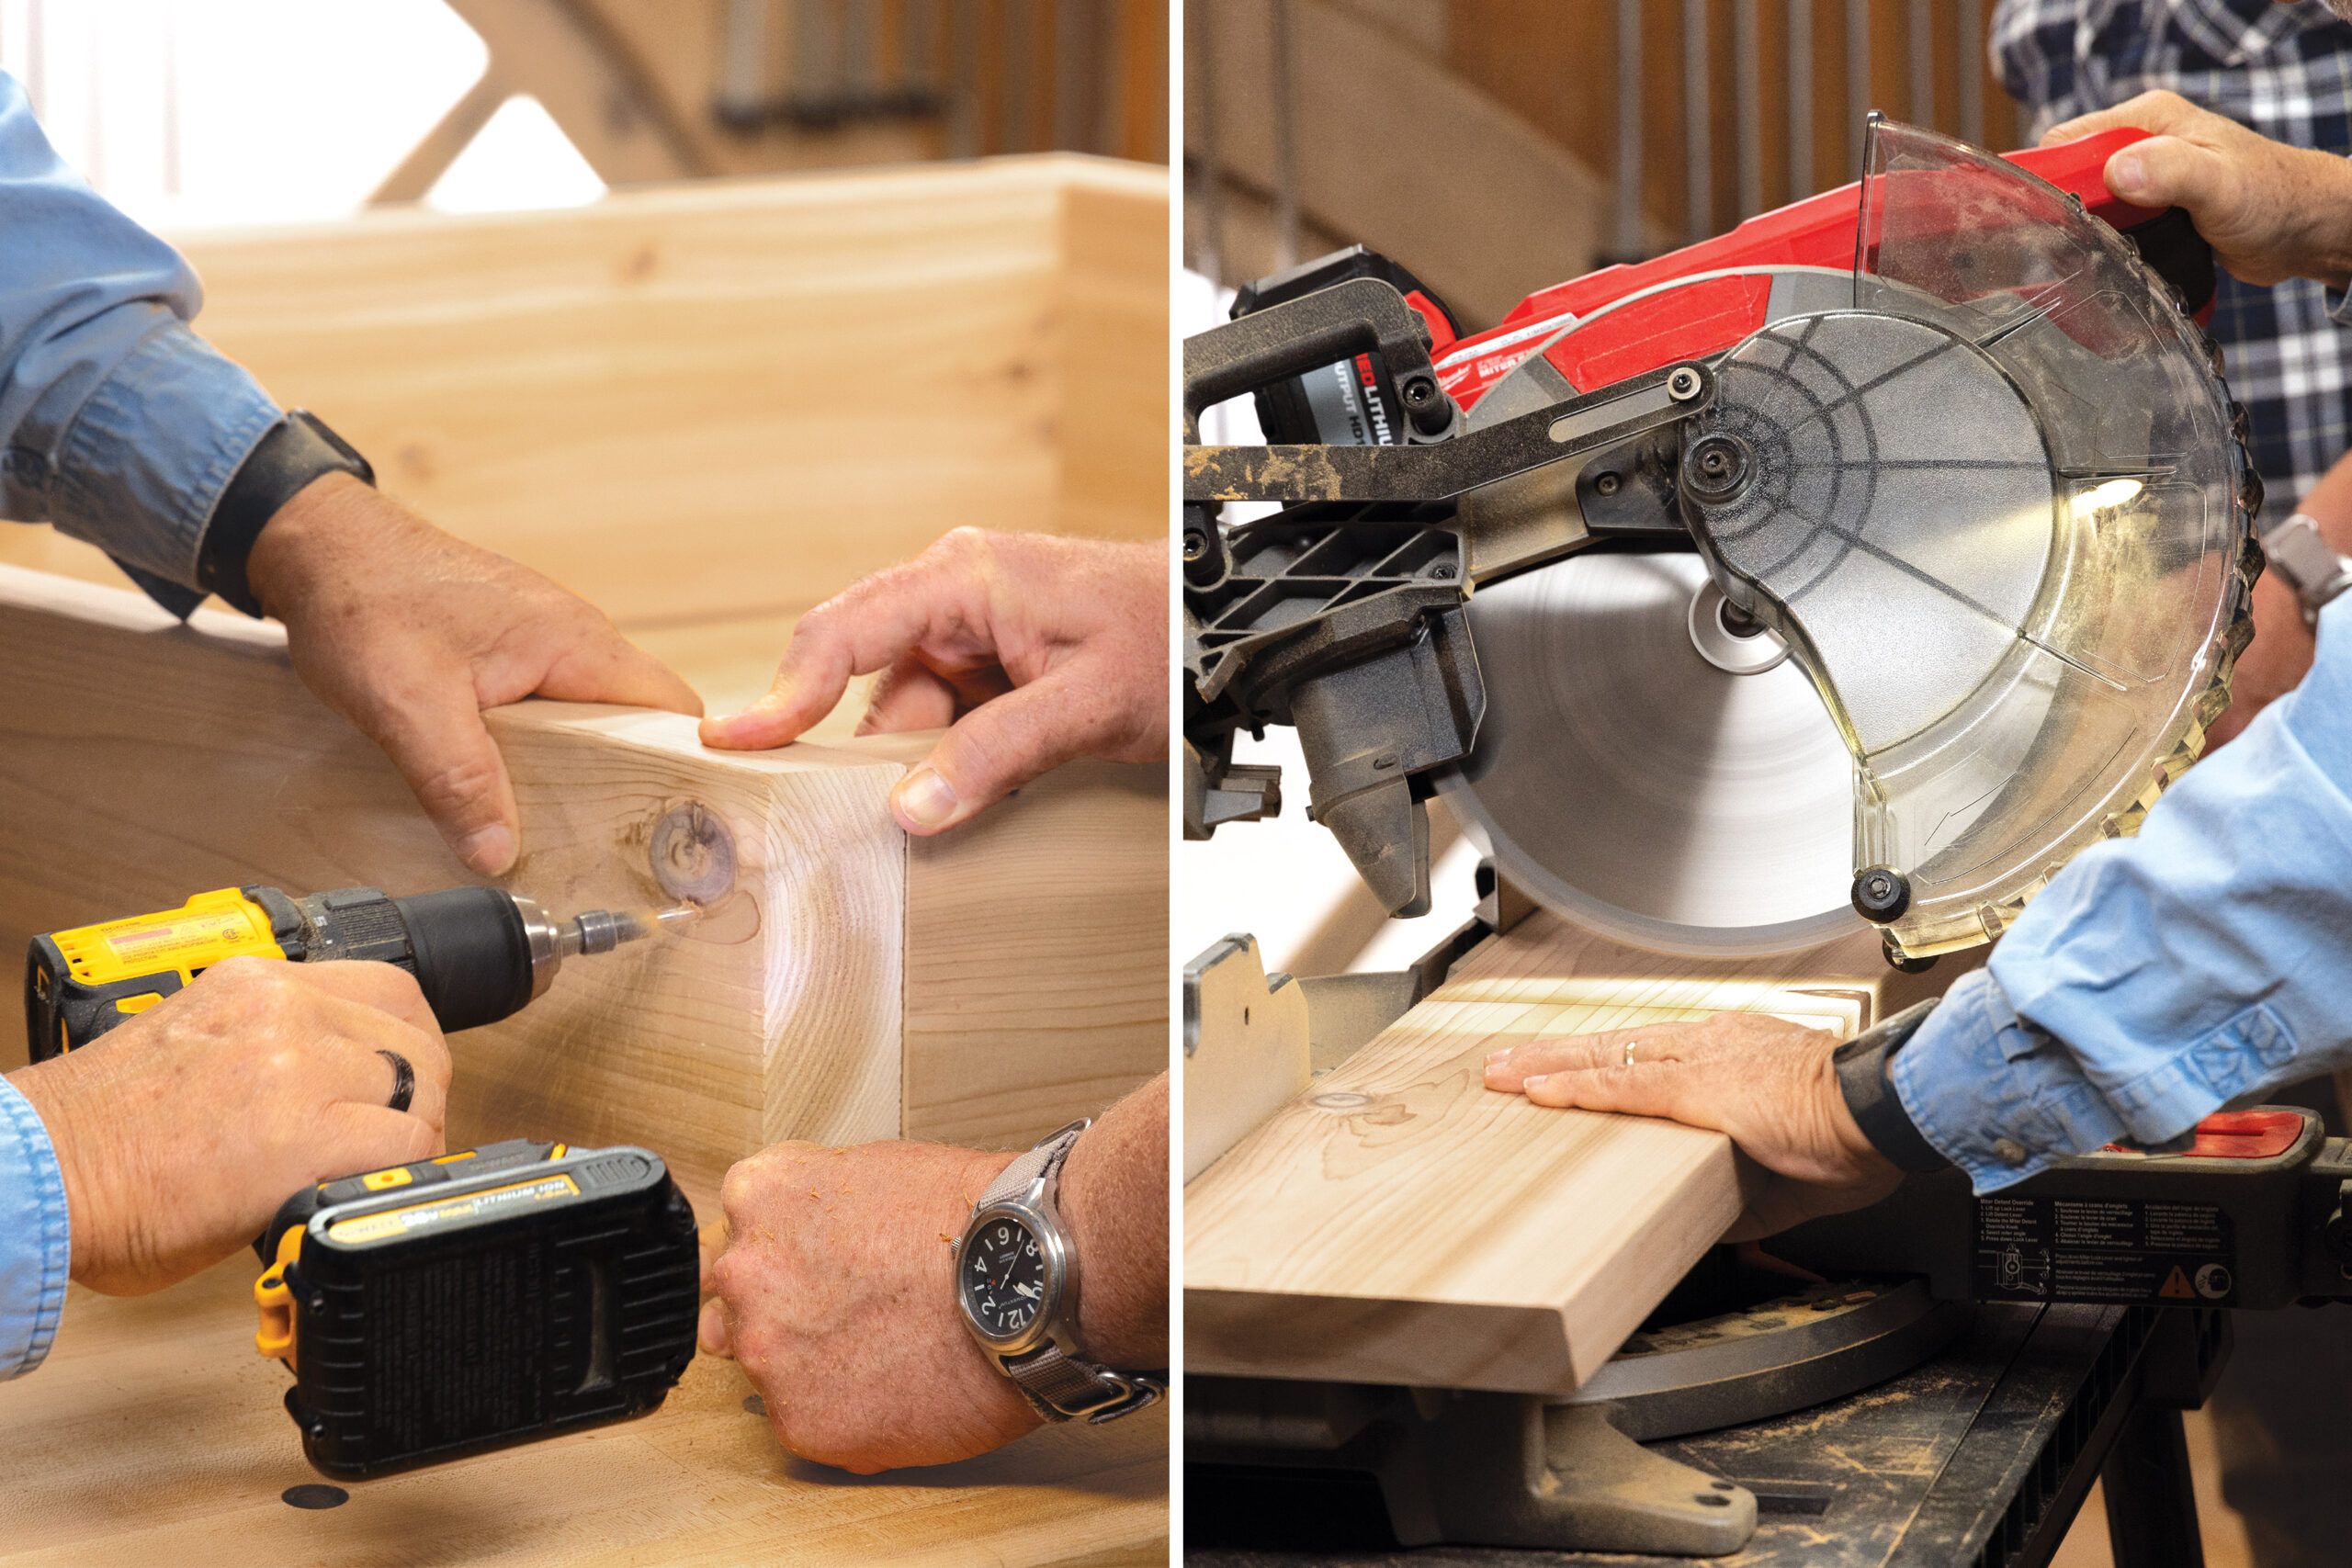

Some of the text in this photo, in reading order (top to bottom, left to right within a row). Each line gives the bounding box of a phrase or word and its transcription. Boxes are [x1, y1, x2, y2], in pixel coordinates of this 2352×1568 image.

[998, 1226, 1010, 1246] 6
[1025, 1238, 1039, 1258] 8
[974, 1256, 988, 1273] 4
[981, 1295, 996, 1315] 2
[1007, 1308, 1027, 1329] 12
